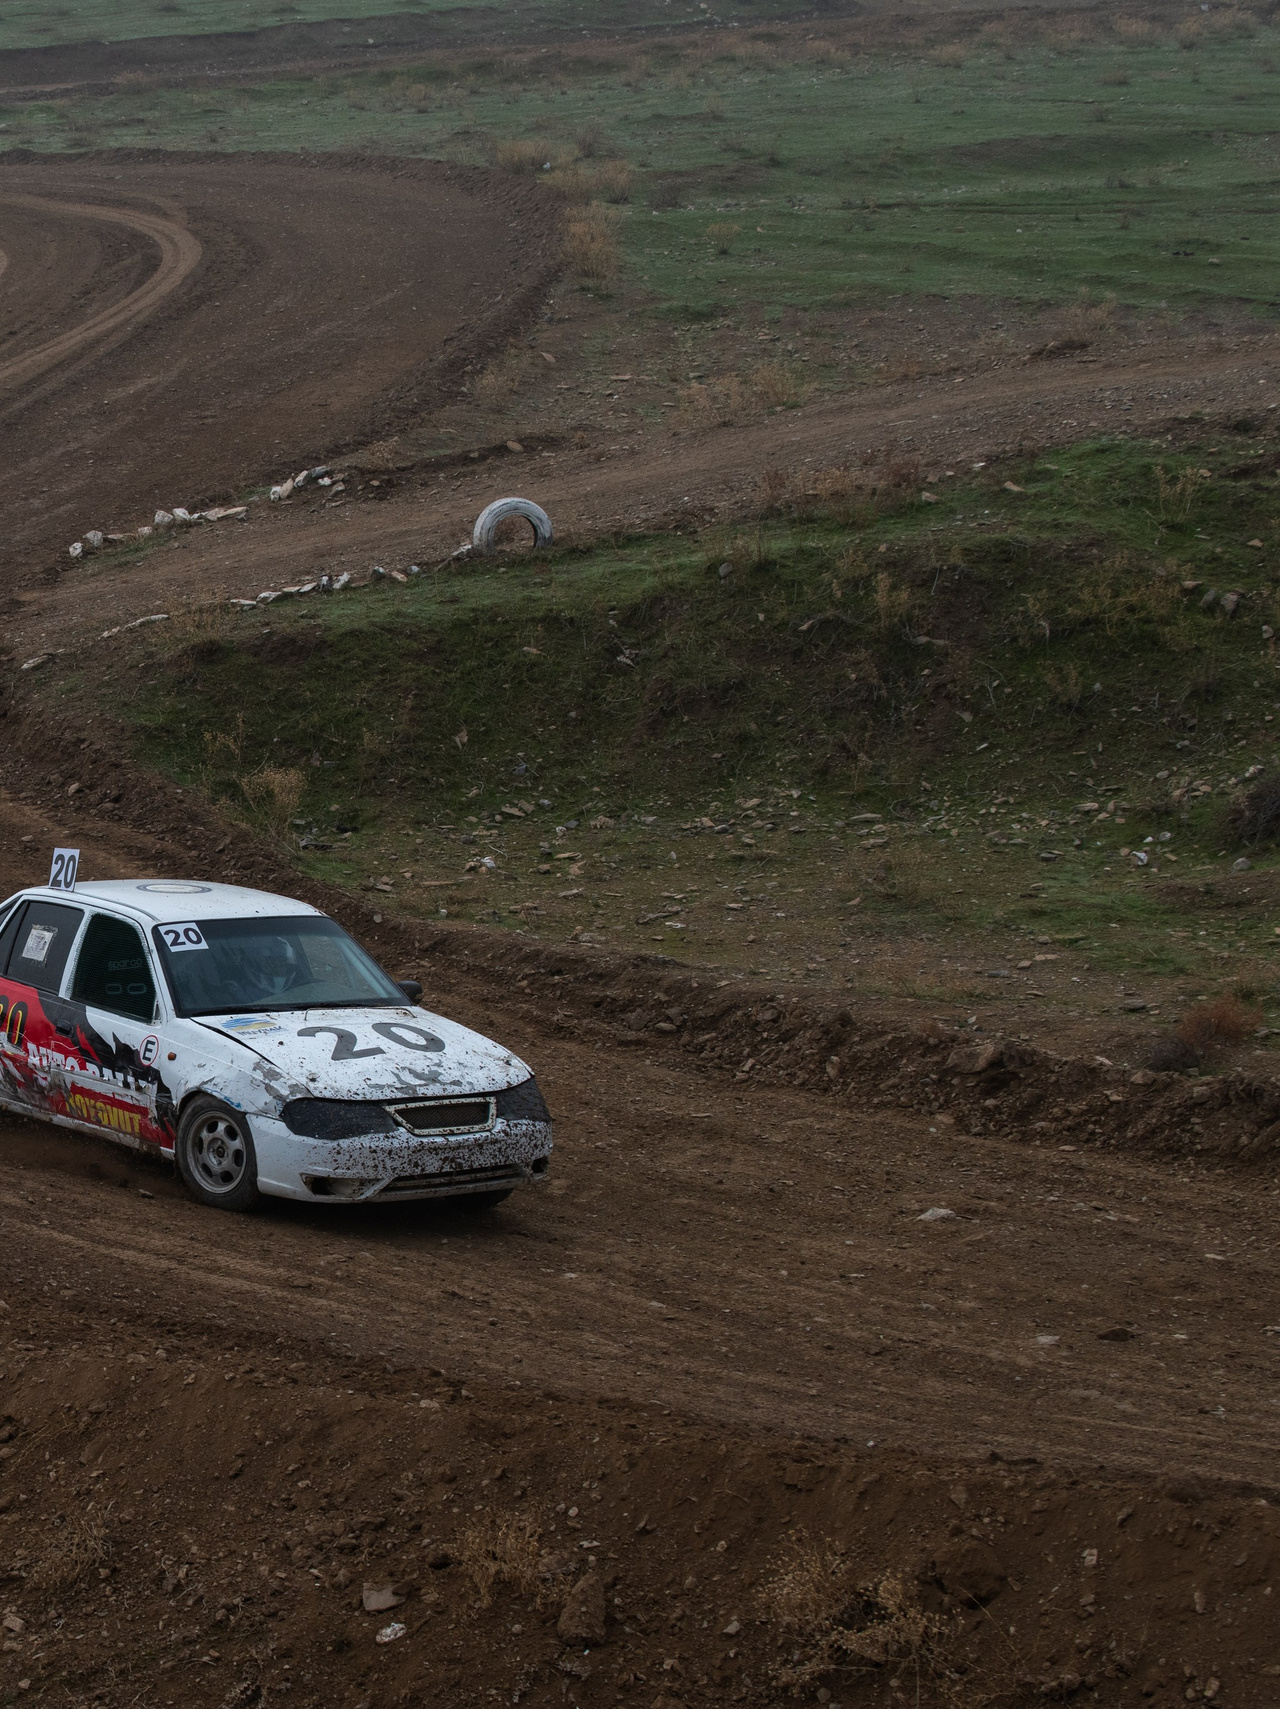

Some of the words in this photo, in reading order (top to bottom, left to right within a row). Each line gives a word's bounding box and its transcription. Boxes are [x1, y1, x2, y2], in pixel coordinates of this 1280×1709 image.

[51, 854, 76, 889] 20
[164, 927, 203, 947] 20
[142, 1039, 156, 1062] E
[297, 1022, 446, 1061] 20
